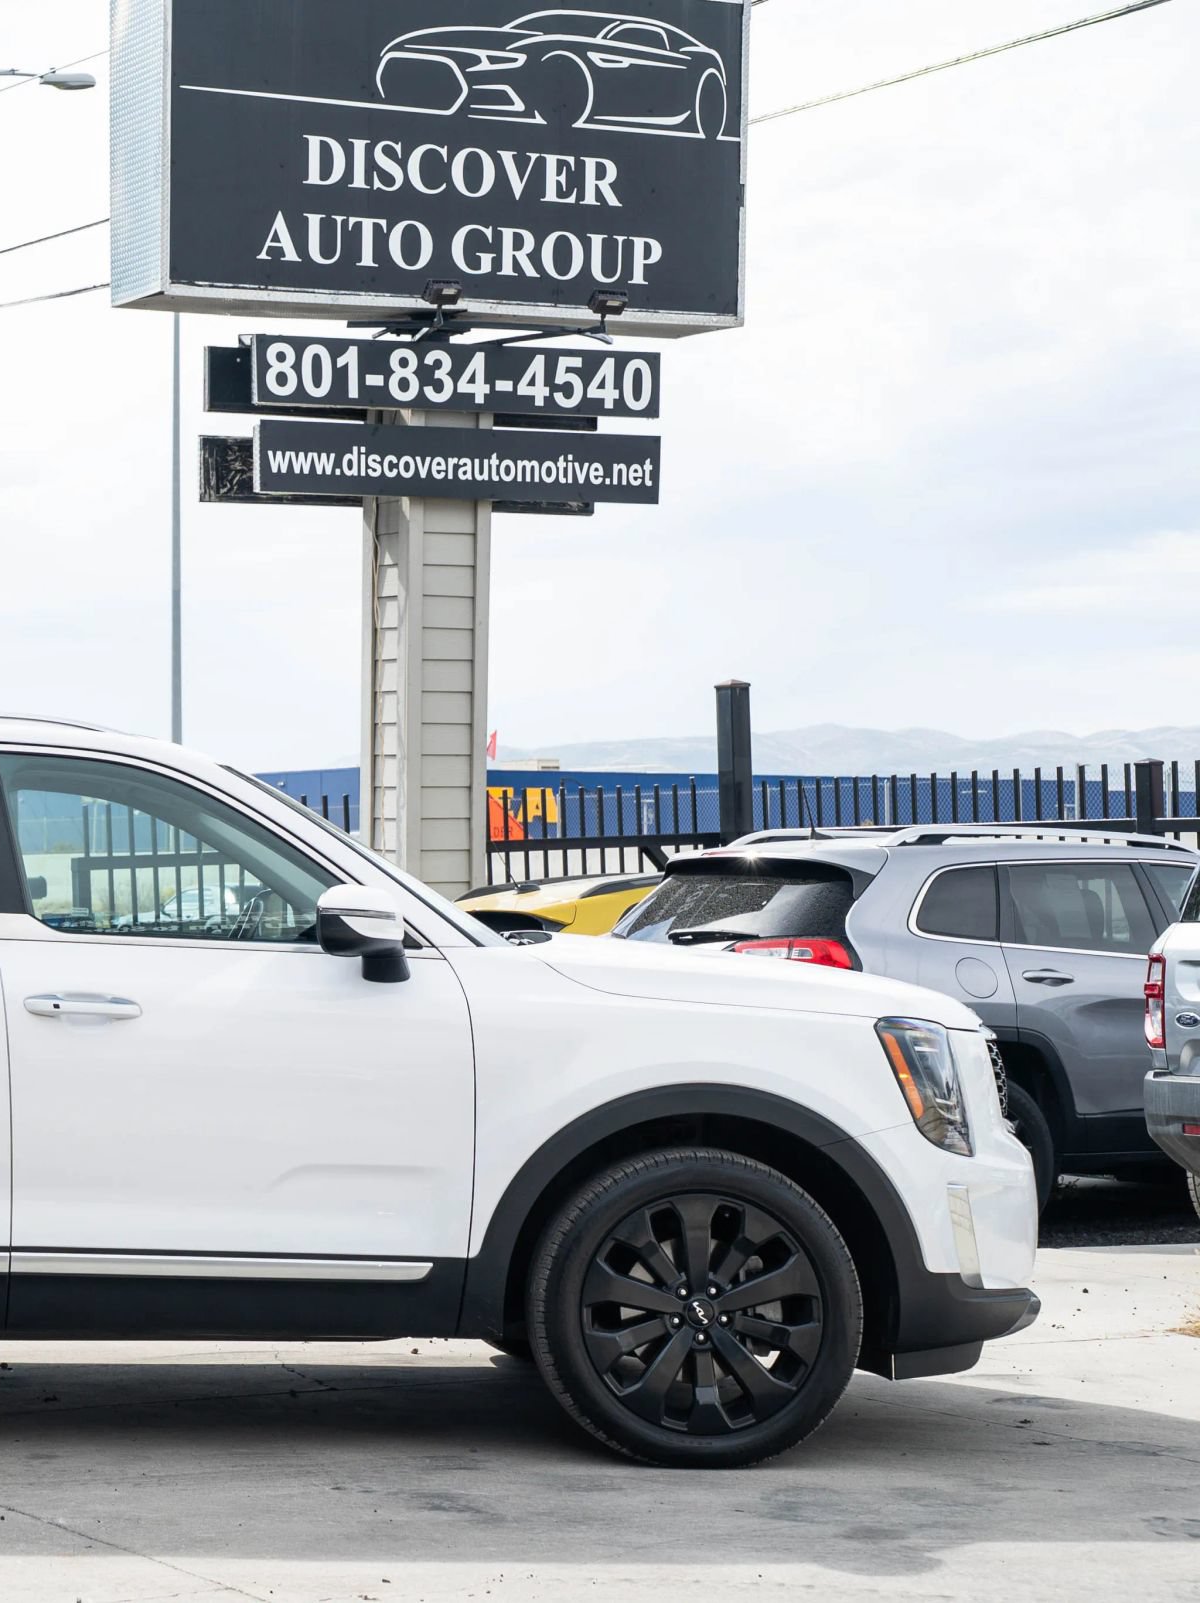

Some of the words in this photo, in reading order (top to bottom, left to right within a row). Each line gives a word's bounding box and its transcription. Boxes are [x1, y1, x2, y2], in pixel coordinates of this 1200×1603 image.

[302, 134, 623, 207] DISCOVER
[256, 210, 434, 271] AUTO
[451, 224, 663, 285] GROUP
[265, 342, 652, 411] 801-834-4540
[267, 445, 653, 487] www.discoverautomotive.net
